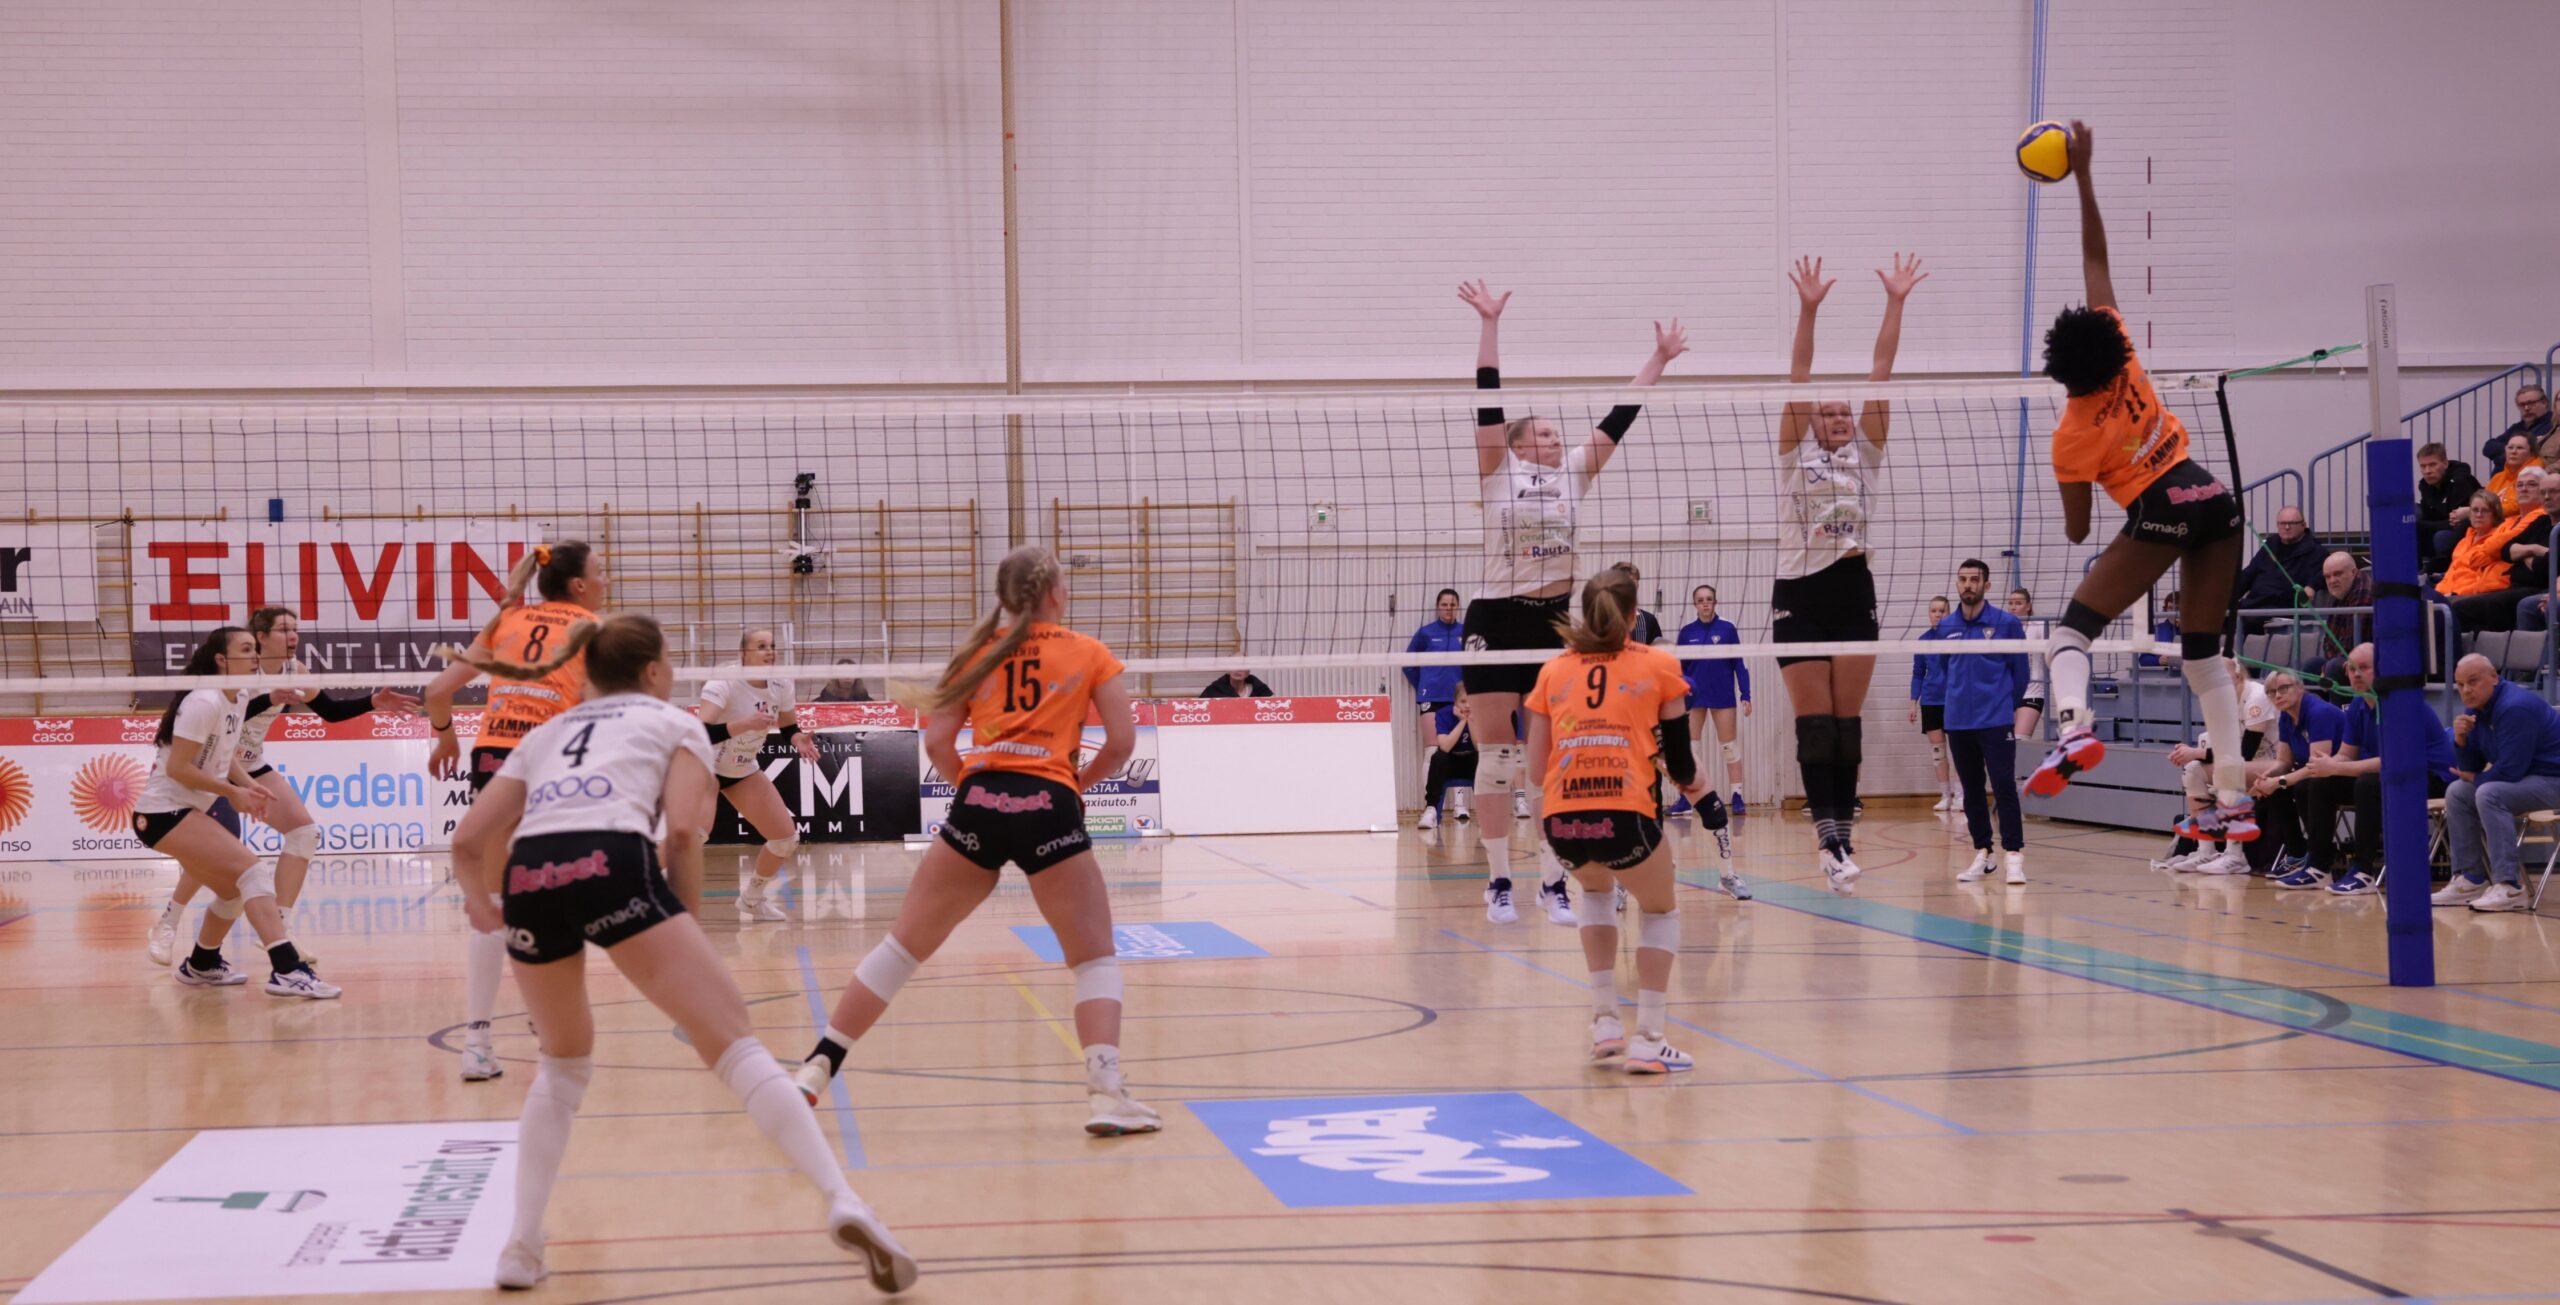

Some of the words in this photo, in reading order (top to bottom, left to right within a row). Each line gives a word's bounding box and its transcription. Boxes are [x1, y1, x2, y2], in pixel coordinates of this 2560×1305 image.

[523, 624, 550, 664] 8
[1003, 659, 1041, 713] 15
[1587, 664, 1607, 710] 9
[861, 716, 900, 727] casco
[1171, 711, 1211, 723] casco
[1254, 710, 1294, 722] casco
[1336, 709, 1376, 721] casco
[32, 731, 75, 743] casco
[121, 730, 158, 742] casc
[284, 727, 326, 740] casco
[371, 725, 412, 738] casco
[562, 721, 596, 769] 4
[1575, 753, 1629, 769] Fennoa
[1562, 775, 1624, 793] LAMMIN
[965, 785, 1053, 814] Betset
[1550, 817, 1616, 840] Betset
[72, 837, 149, 851] storaens
[509, 849, 611, 896] Betset
[340, 1156, 497, 1265] lattiamestarit
